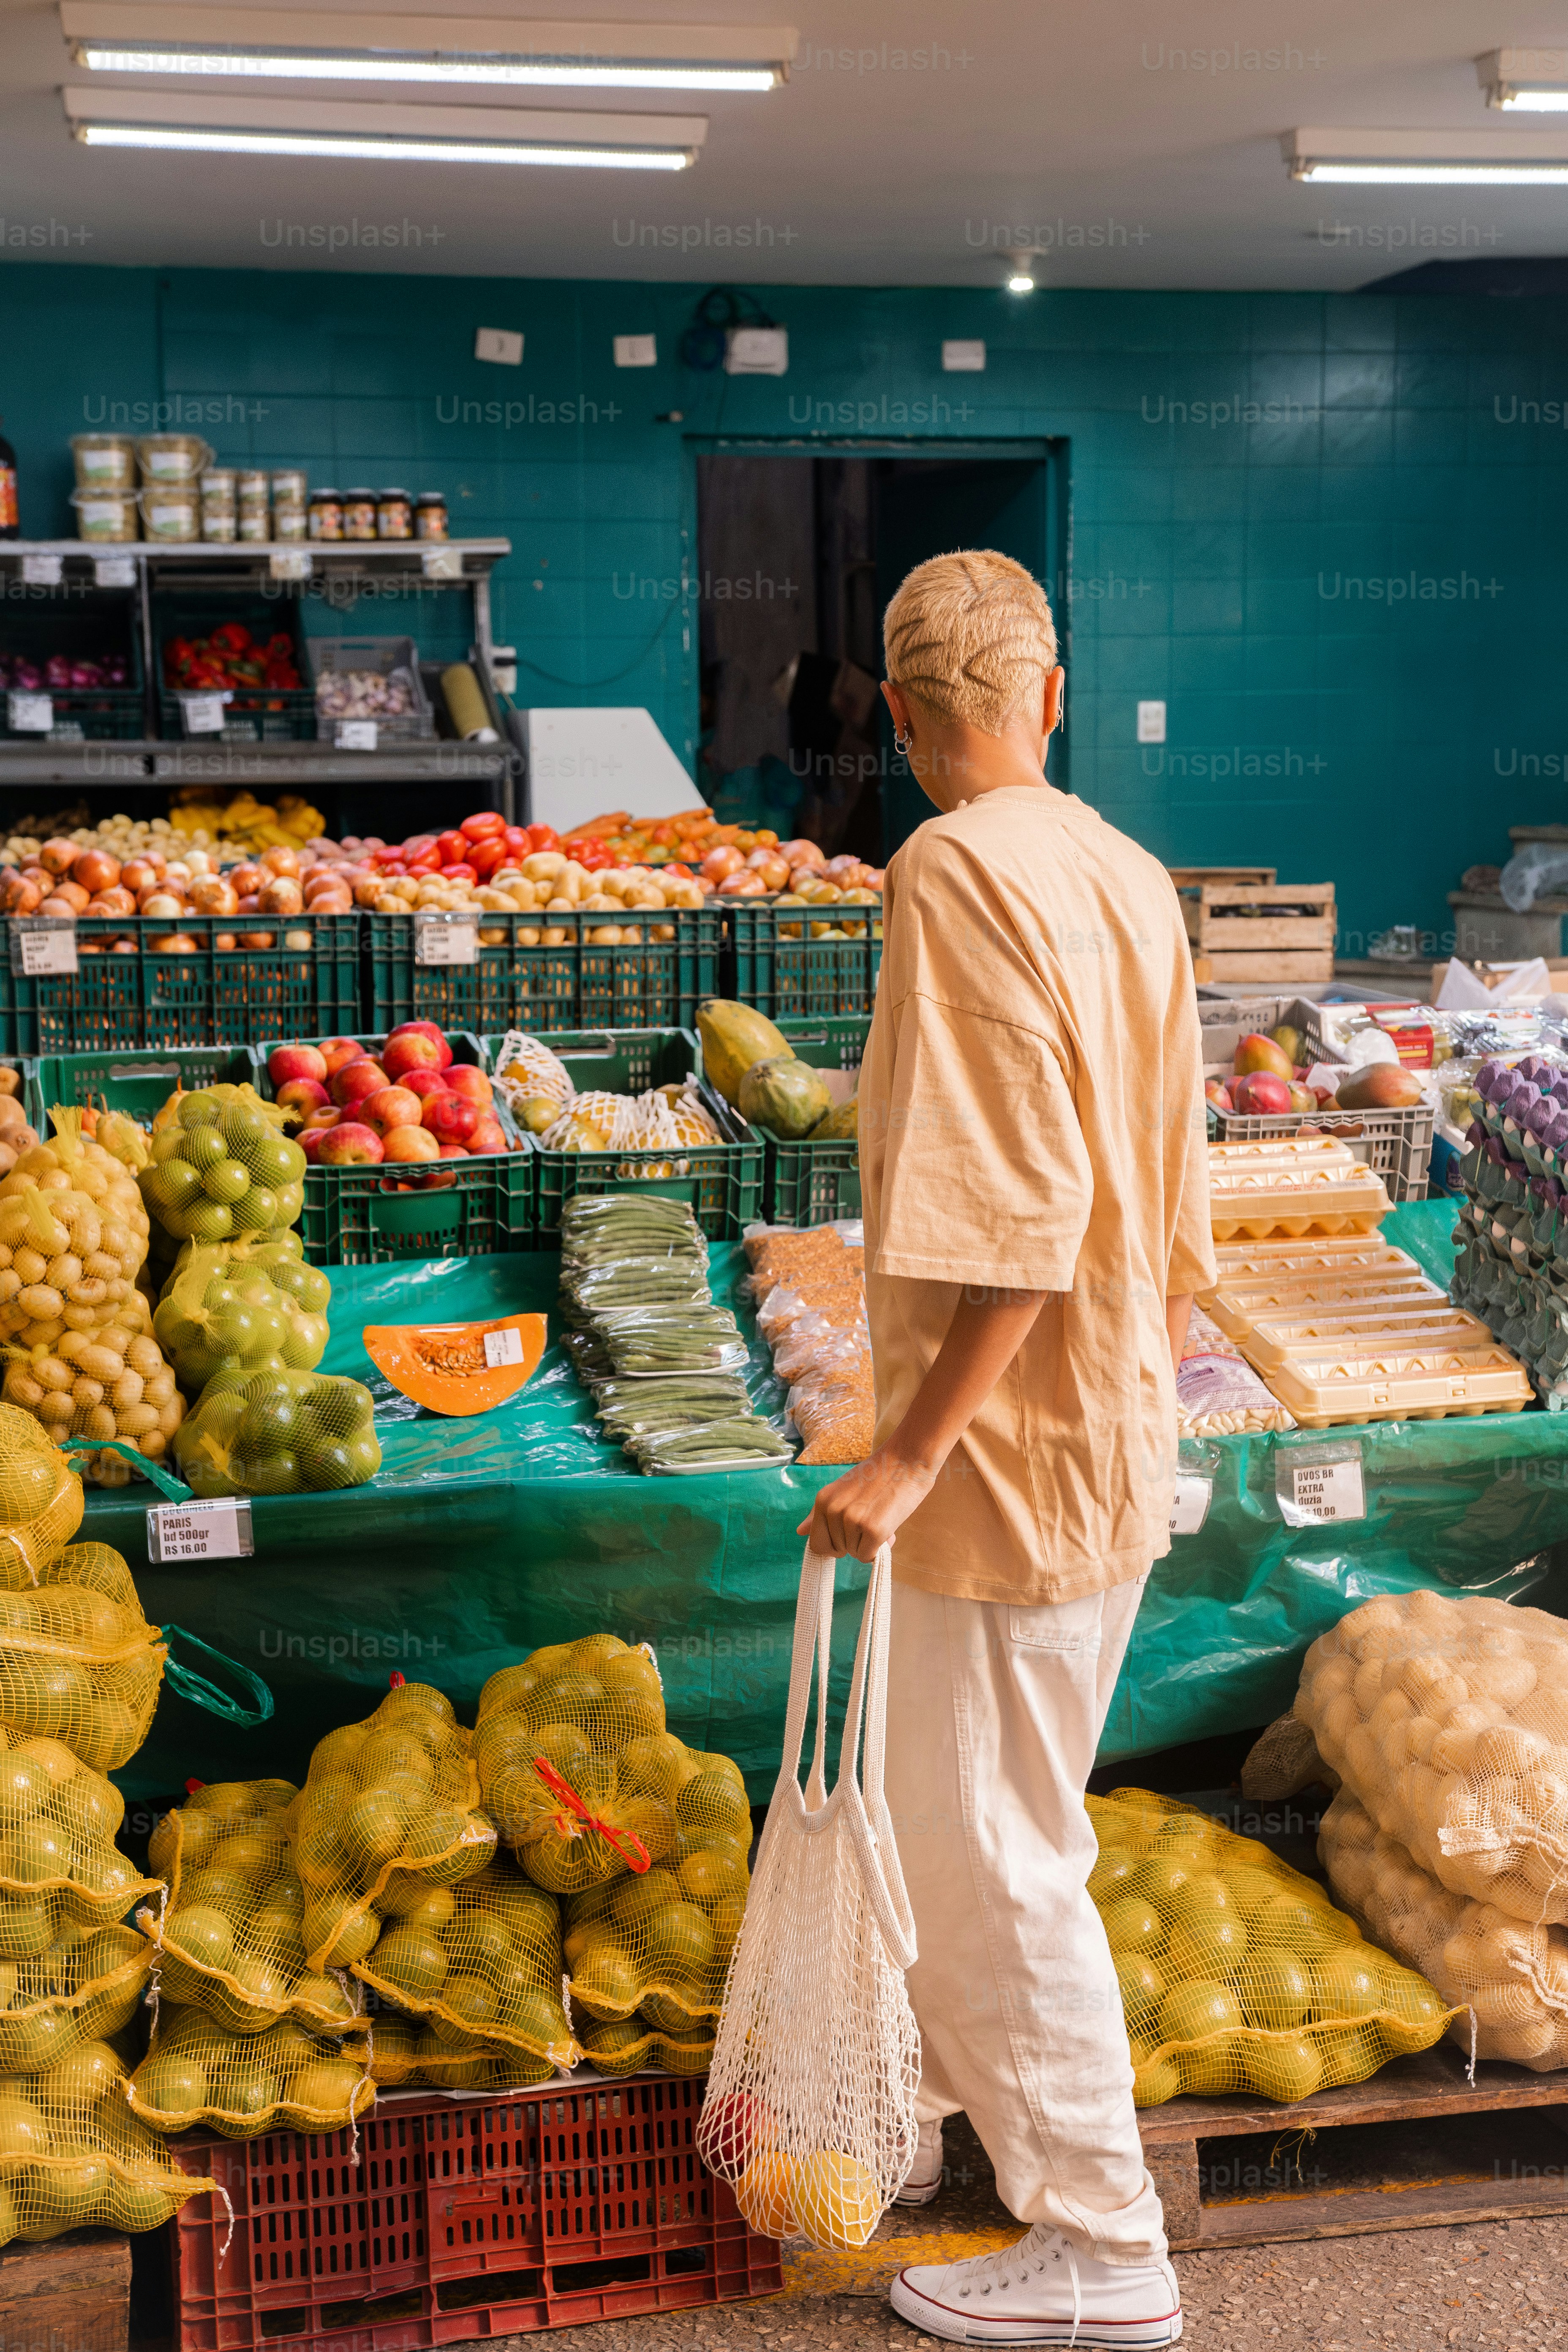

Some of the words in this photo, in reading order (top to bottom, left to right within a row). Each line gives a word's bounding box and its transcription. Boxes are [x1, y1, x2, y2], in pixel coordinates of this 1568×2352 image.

[1298, 1470, 1320, 1481] OVOS
[1323, 1469, 1334, 1478] BR
[1298, 1483, 1324, 1494] EXTRA
[1298, 1496, 1322, 1505] duzia
[1312, 1506, 1335, 1517] 10,00
[163, 1517, 191, 1530] PARIS
[164, 1532, 176, 1542] bd
[179, 1530, 210, 1541] 500gr
[165, 1544, 178, 1555] R$
